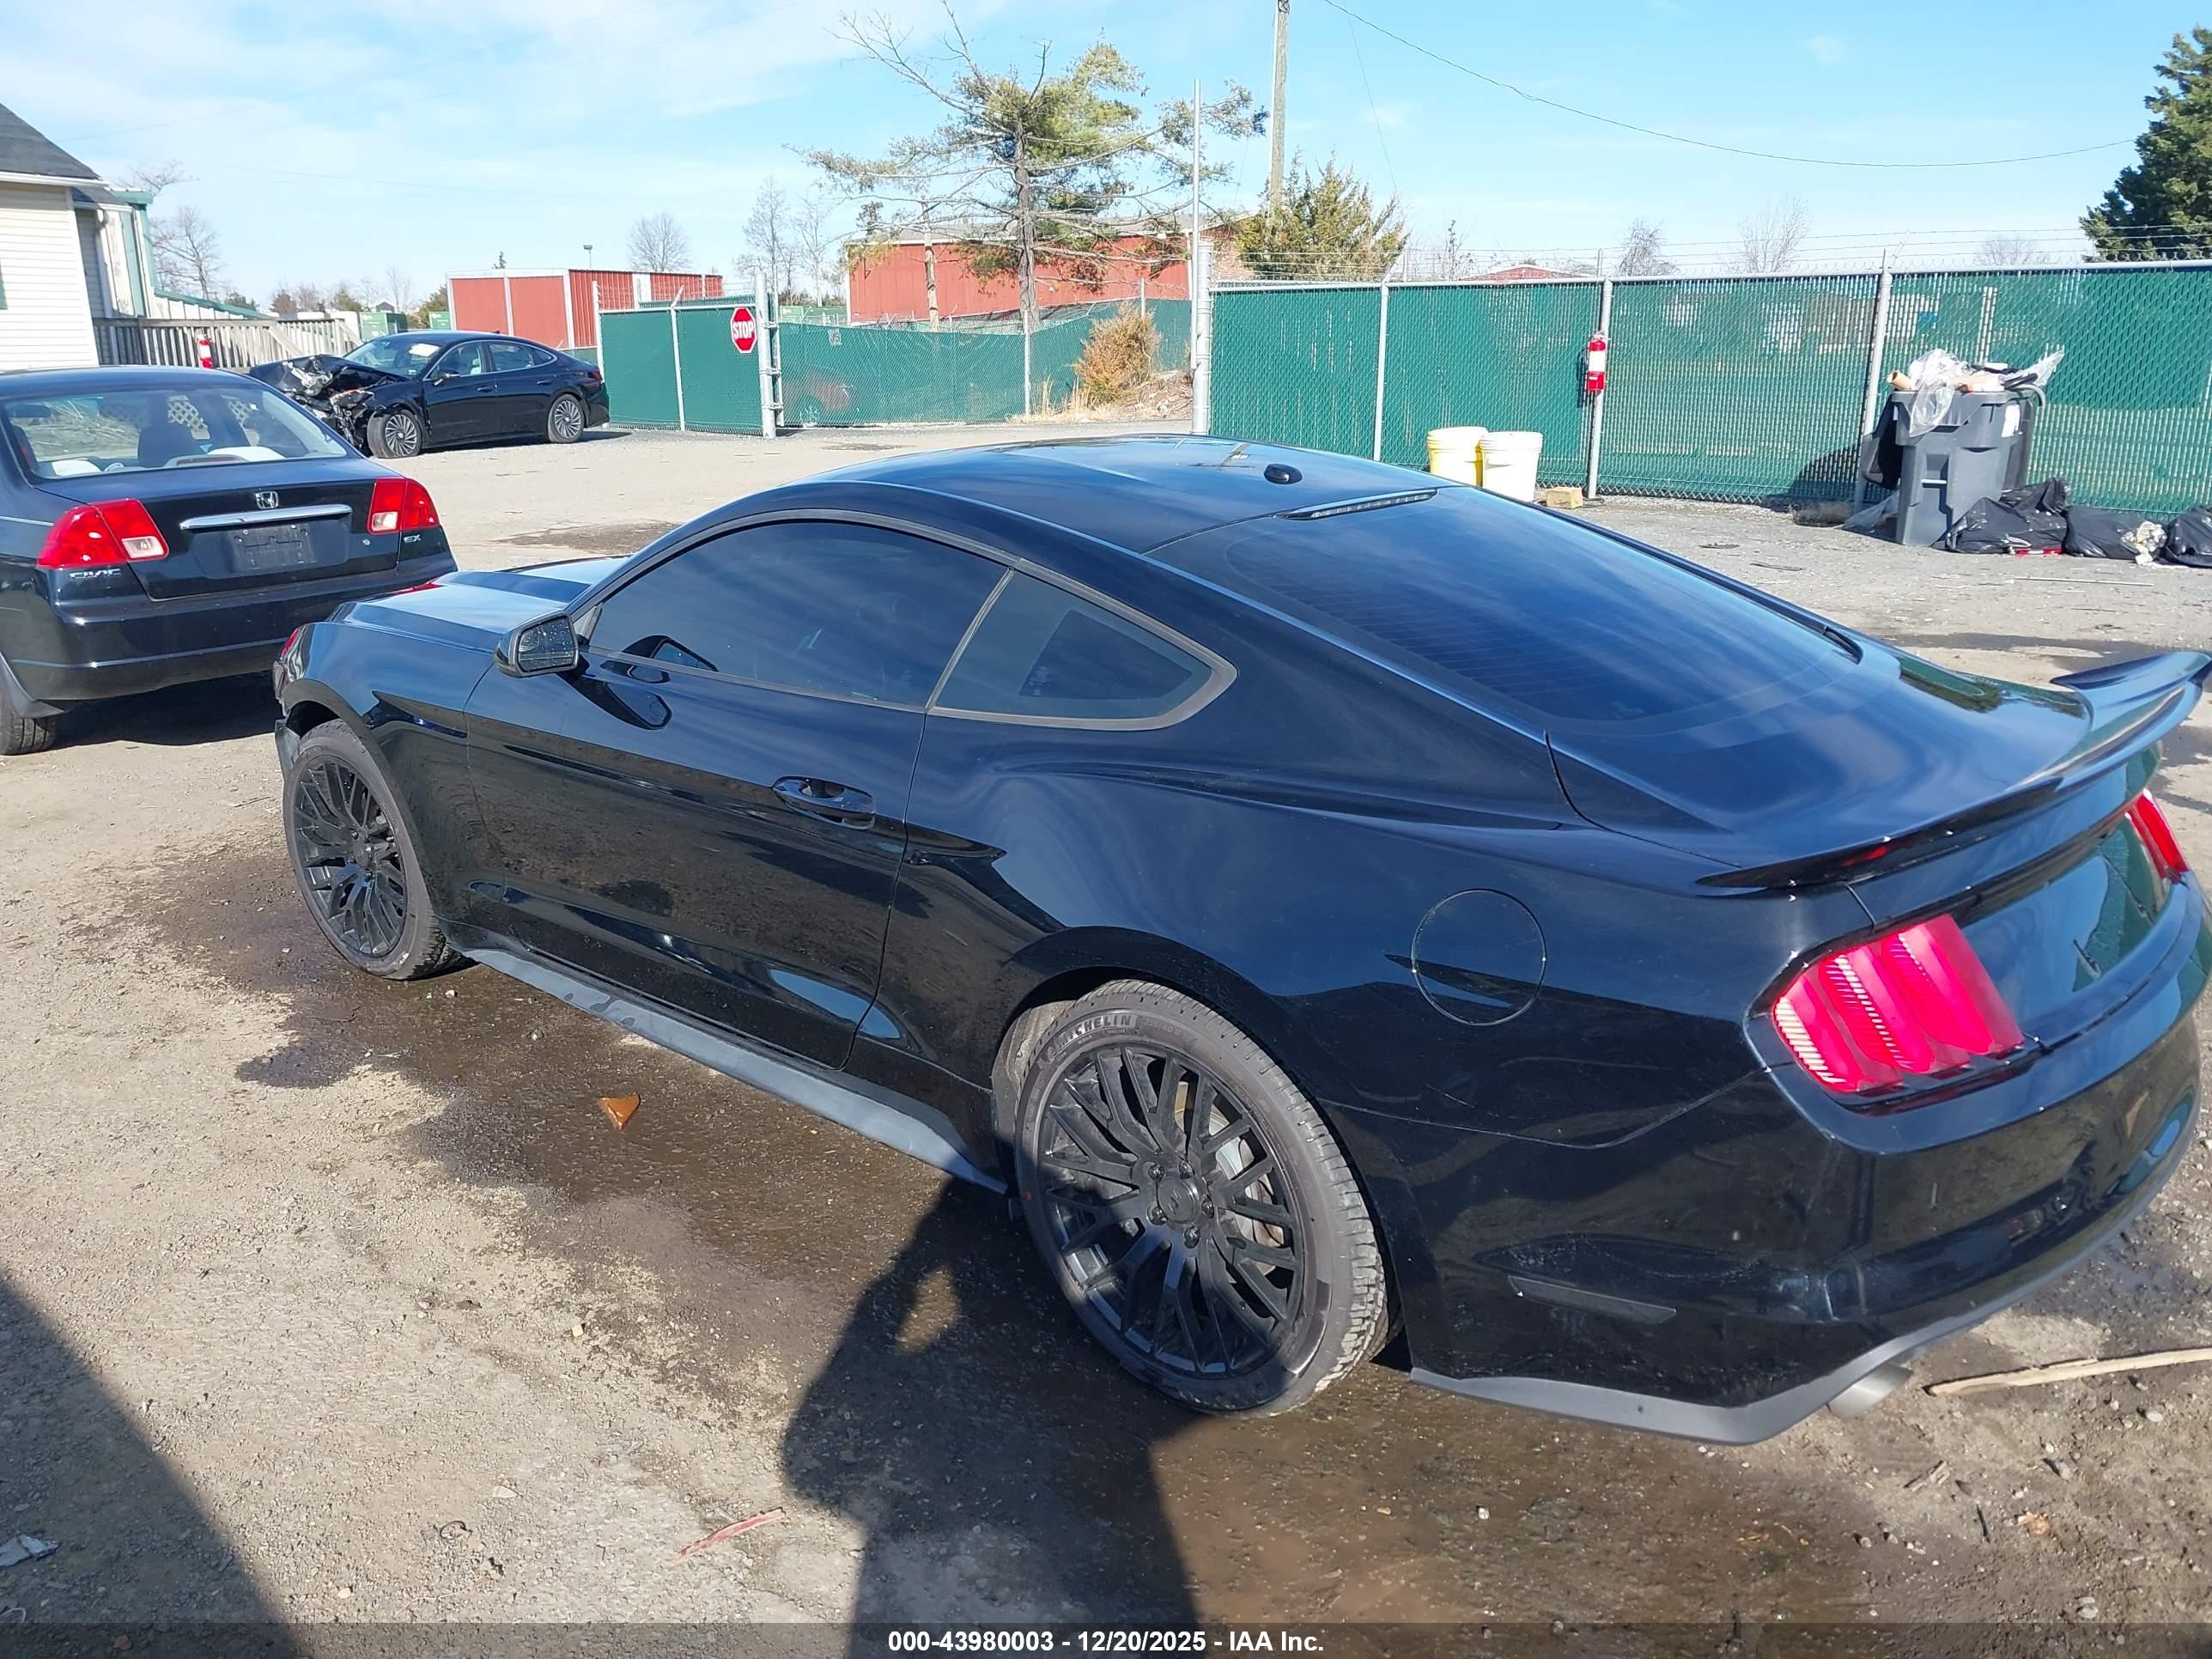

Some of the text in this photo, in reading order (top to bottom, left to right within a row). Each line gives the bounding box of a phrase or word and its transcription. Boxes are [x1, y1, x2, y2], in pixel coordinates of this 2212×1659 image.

[732, 320, 754, 340] STOP
[404, 534, 422, 544] EX
[69, 568, 121, 579] CIVIC
